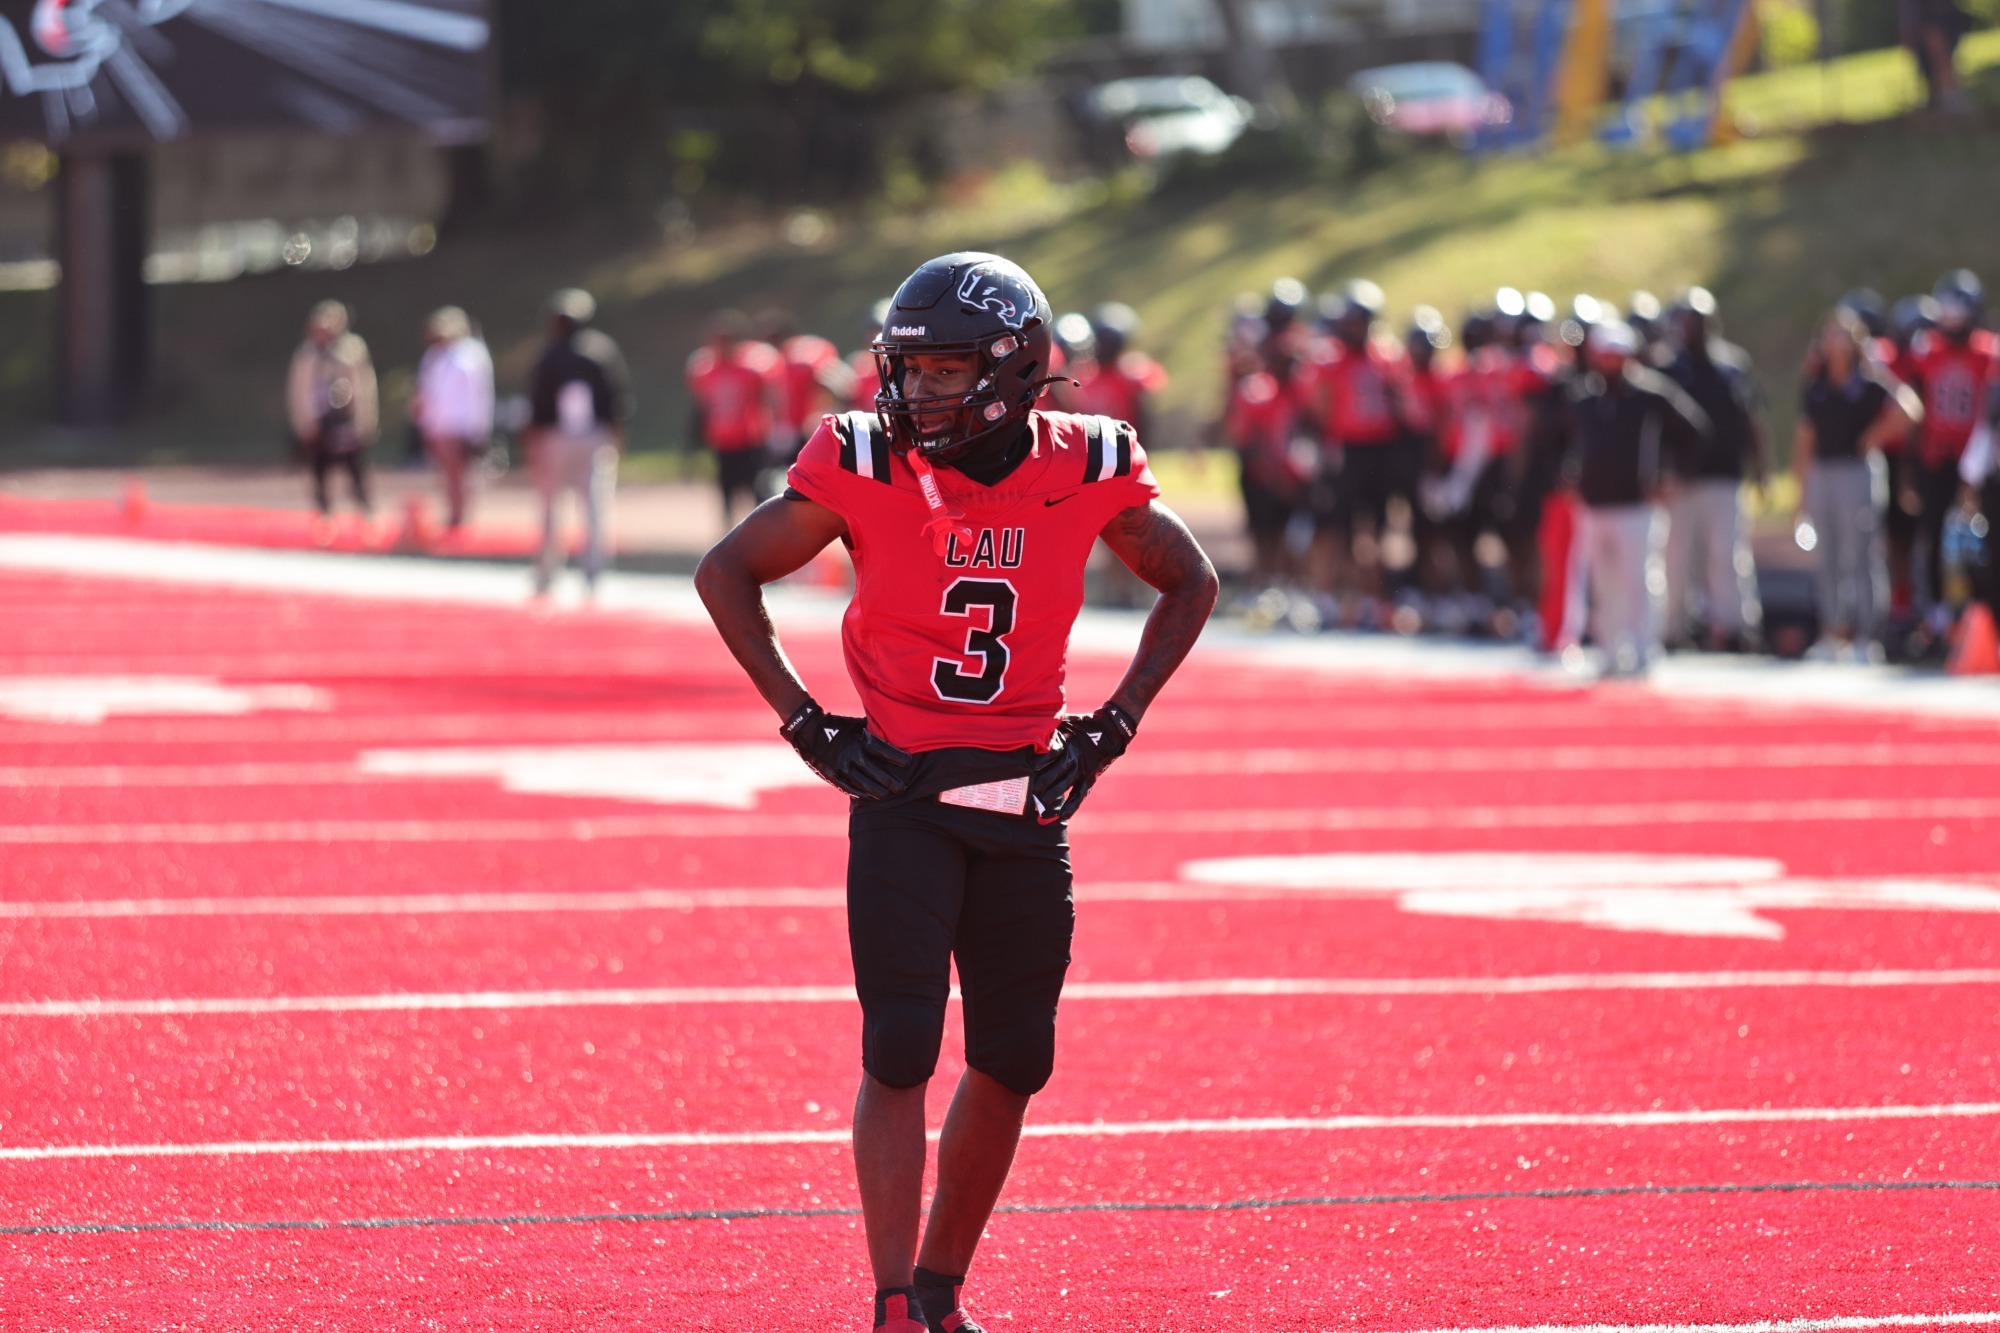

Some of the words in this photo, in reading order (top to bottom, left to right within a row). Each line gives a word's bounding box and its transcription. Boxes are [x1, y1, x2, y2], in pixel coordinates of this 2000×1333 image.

[891, 325, 926, 336] Riddell
[919, 474, 942, 510] NXTRND
[945, 528, 1025, 569] CAU
[929, 575, 1019, 704] 3
